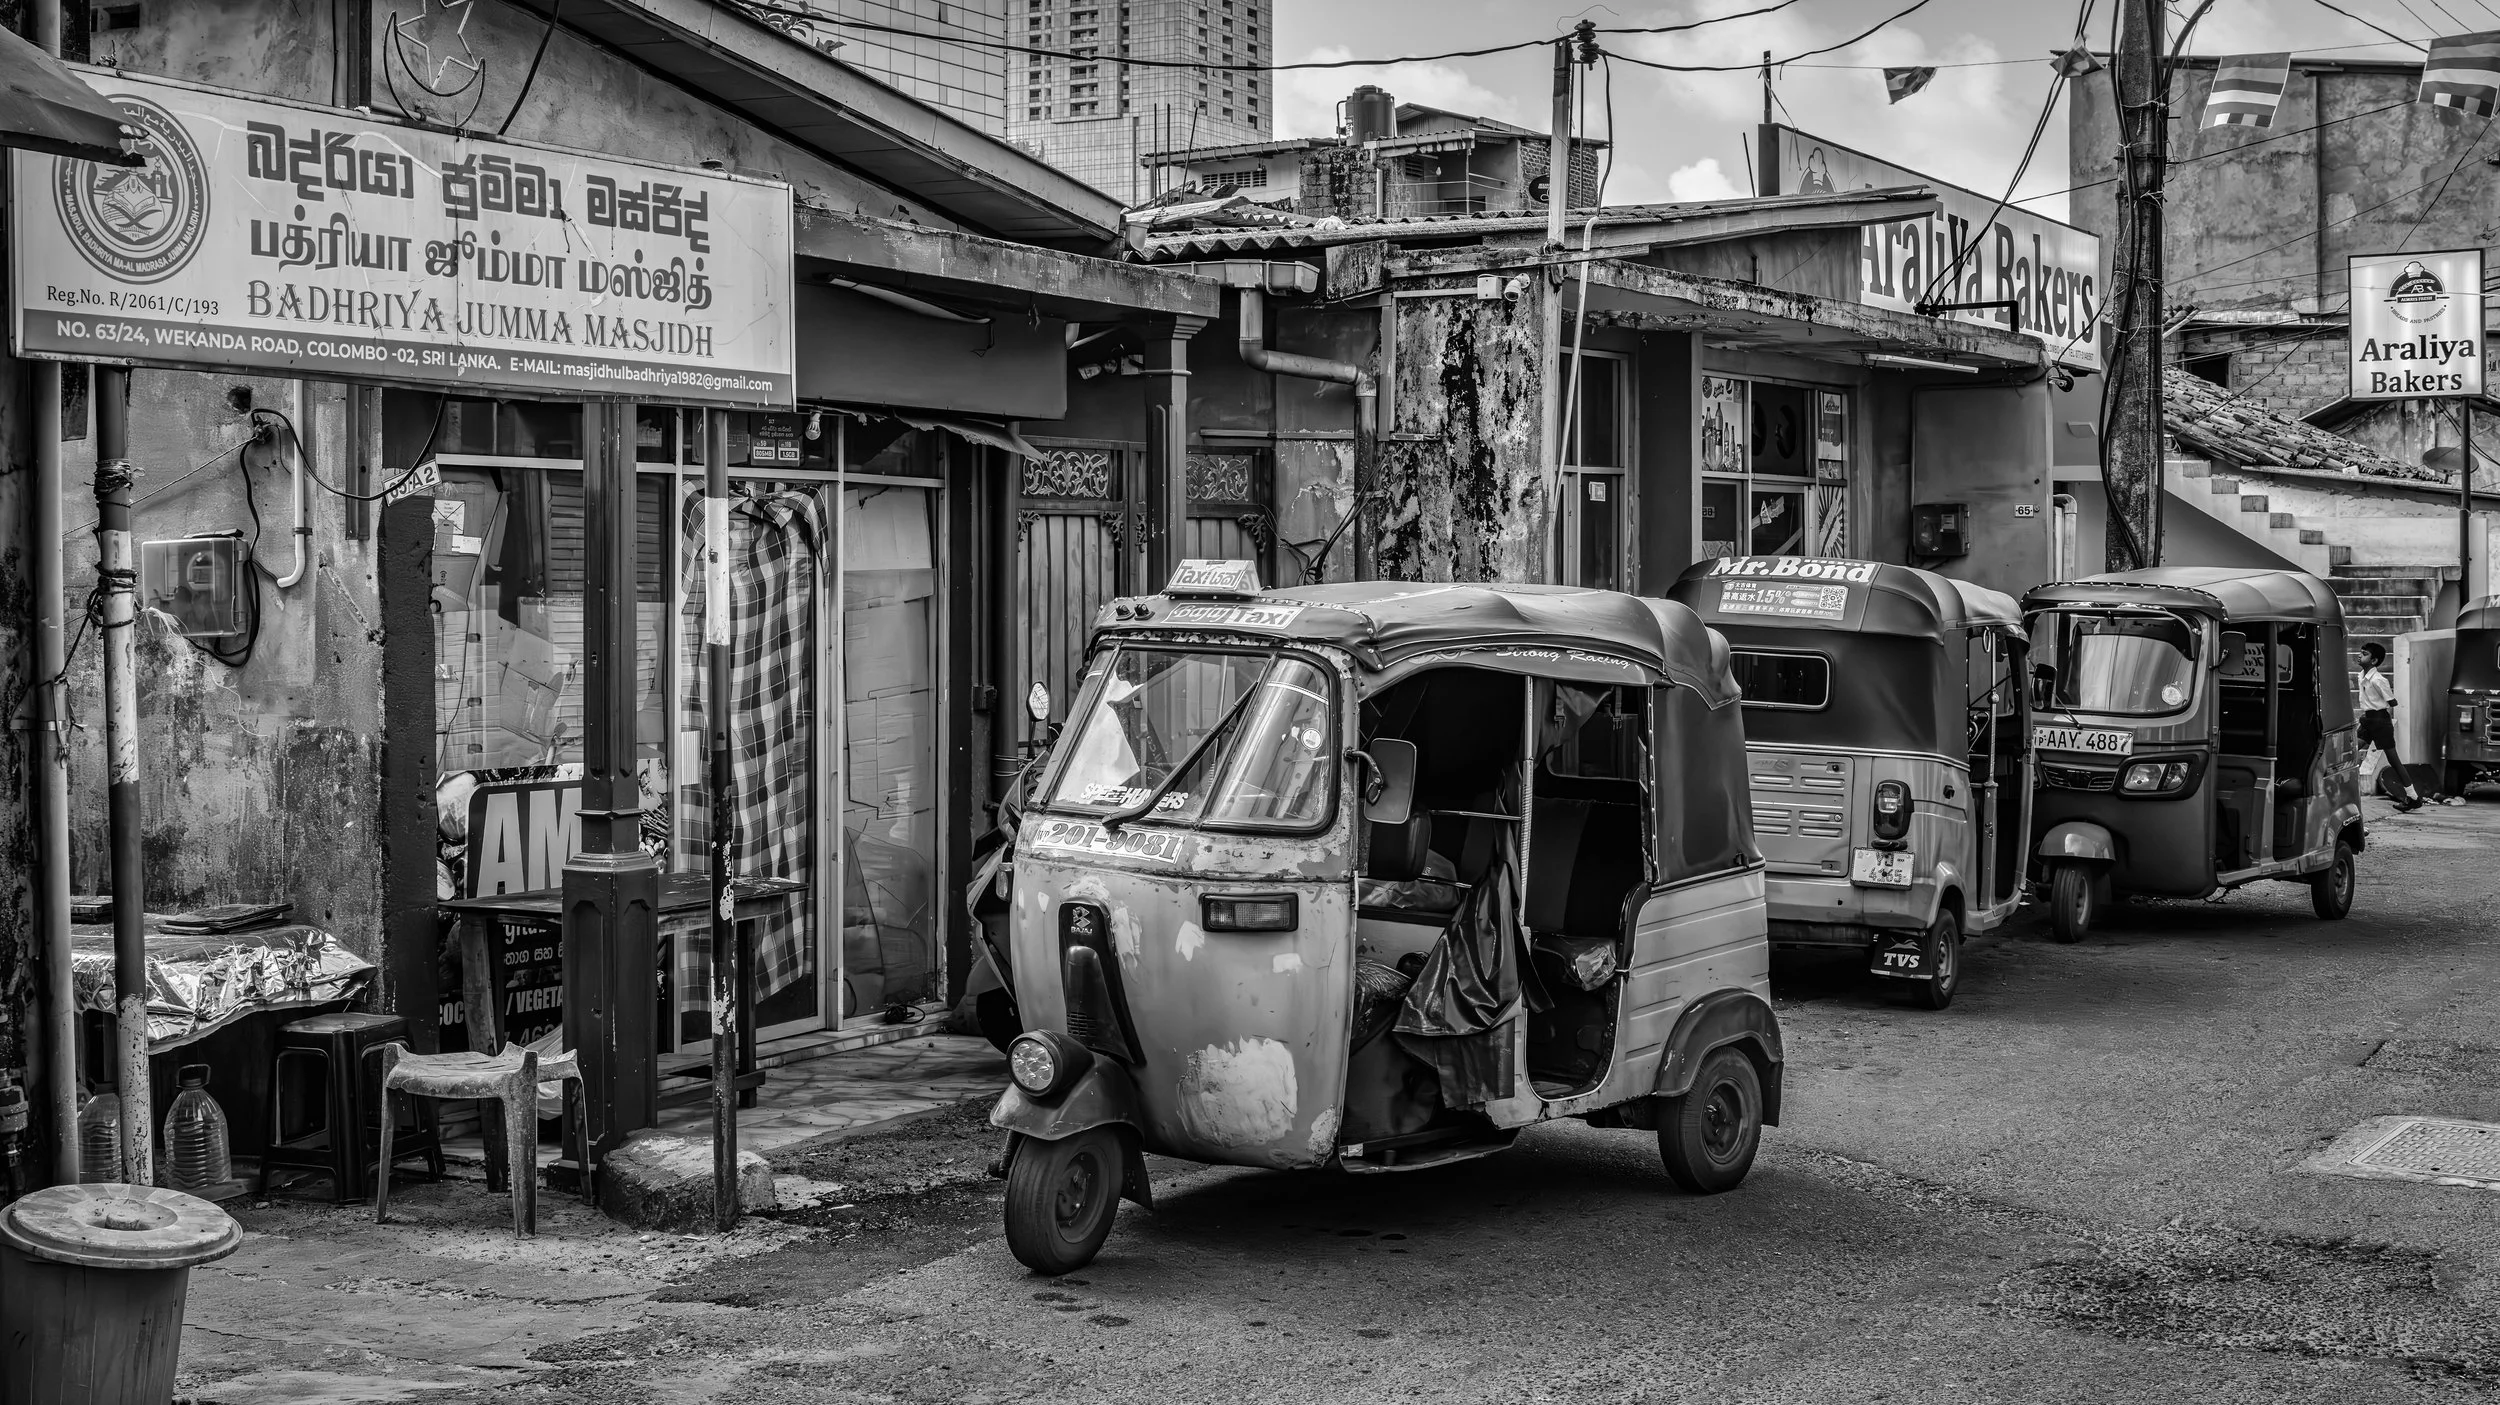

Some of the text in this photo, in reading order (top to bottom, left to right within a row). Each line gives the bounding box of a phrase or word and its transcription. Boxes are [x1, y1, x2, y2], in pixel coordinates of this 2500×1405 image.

[250, 204, 412, 273] பத்ரியா
[578, 248, 712, 316] மஸ்ஜித்
[1994, 221, 2095, 345] Bakers
[109, 291, 219, 317] R/2061/C/193
[247, 279, 714, 358] BADHRIYA JUMMA MASJIDH
[56, 319, 91, 339] NO.
[95, 322, 150, 346] 63/24,
[154, 327, 247, 351] WEKANDA
[251, 336, 303, 358] ROAD,
[307, 340, 388, 362] COLOMBO
[422, 350, 446, 366] SRI
[449, 352, 501, 370] LANKA.
[510, 356, 561, 376] E-MAIL:
[563, 359, 773, 393] masjidhulbadhriya1982@gmail.com
[2359, 334, 2476, 364] Araliya
[2370, 369, 2464, 396] Bakers
[1174, 604, 1295, 625] Bajaj Taxi
[1566, 650, 1630, 670] Racing
[2085, 733, 2133, 752] 4887
[1045, 822, 1181, 861] 201-9081
[1883, 952, 1921, 968] TVS
